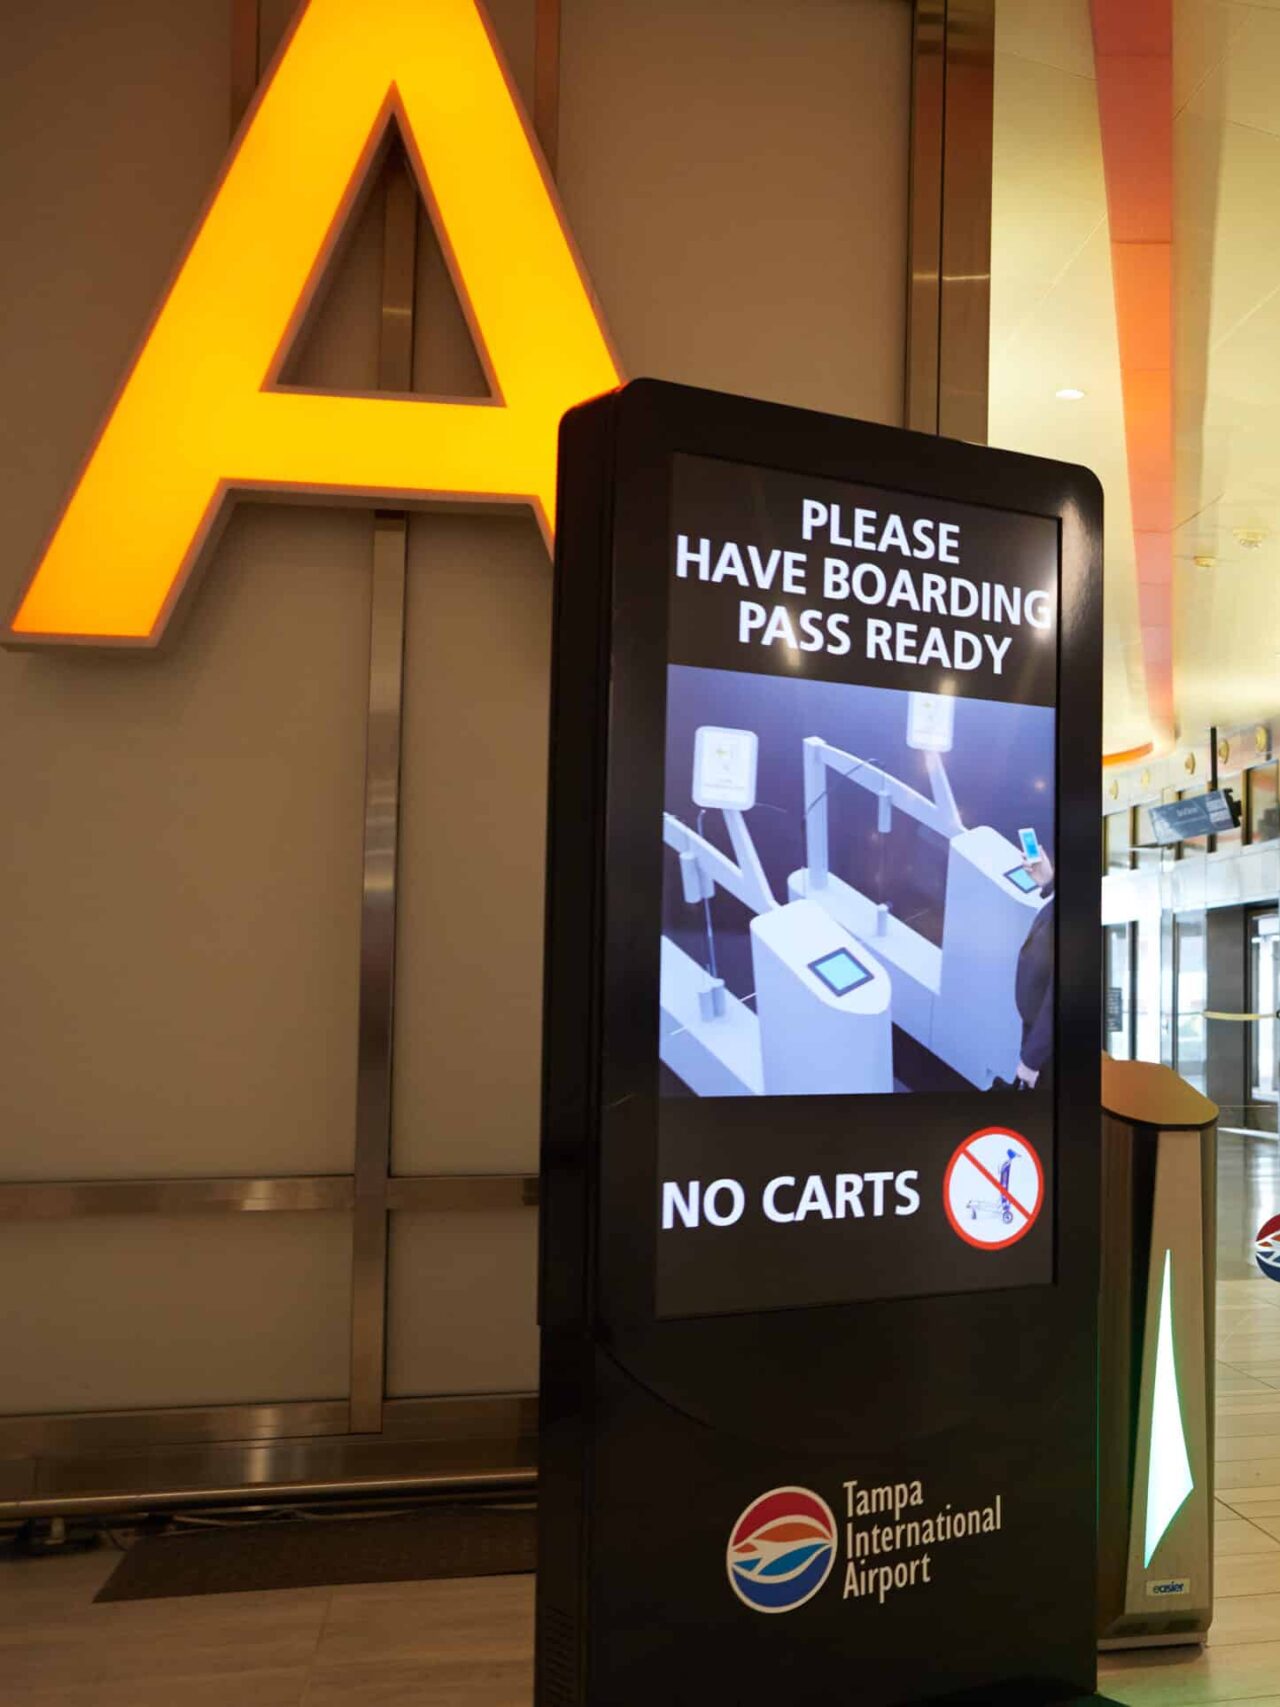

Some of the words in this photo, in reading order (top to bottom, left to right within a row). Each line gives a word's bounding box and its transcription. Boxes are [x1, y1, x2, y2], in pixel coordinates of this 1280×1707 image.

[5, 0, 630, 646] A
[802, 498, 961, 565] PLEASE
[675, 534, 807, 596] HAVE
[822, 557, 1052, 631] BOARDING
[737, 600, 852, 656] PASS
[865, 617, 1013, 676] READY
[661, 1179, 746, 1231] NO
[761, 1169, 921, 1224] CARTS
[842, 1479, 924, 1521] Tampa
[846, 1493, 1002, 1560] International
[842, 1553, 932, 1605] Airport
